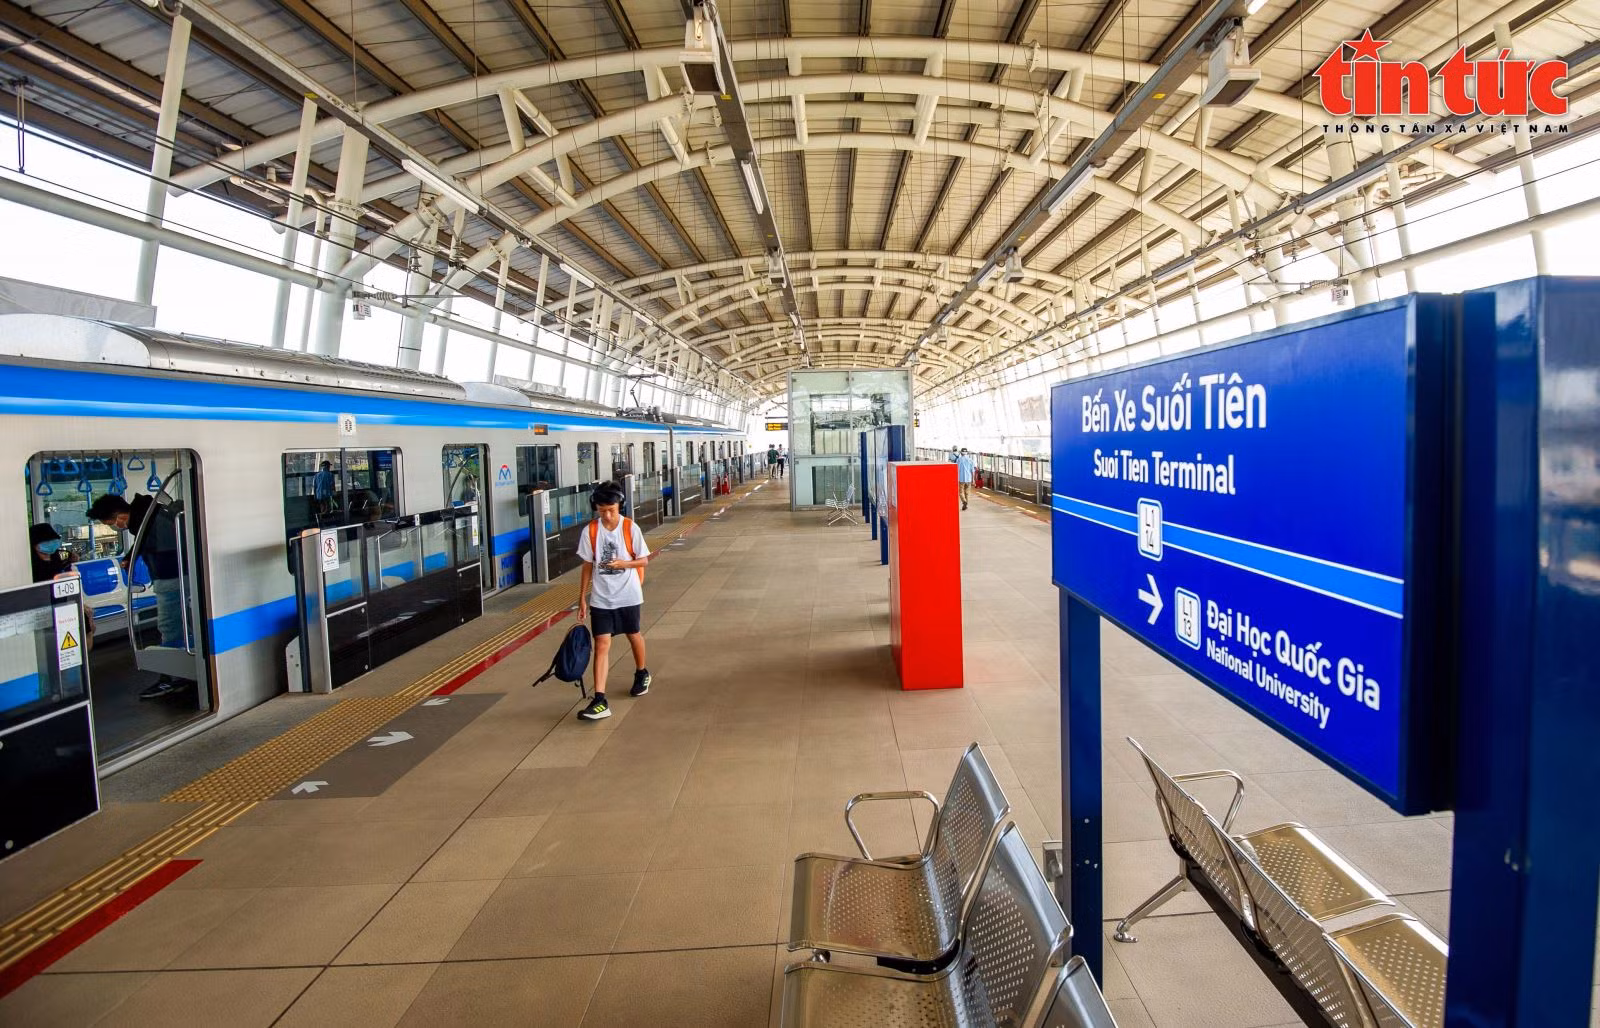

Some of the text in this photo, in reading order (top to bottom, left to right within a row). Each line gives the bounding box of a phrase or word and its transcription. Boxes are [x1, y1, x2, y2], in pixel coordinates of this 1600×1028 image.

[1081, 372, 1267, 433] Bến Xe Suối Tiên
[1094, 449, 1236, 496] Suoi Tien Terminal
[1145, 530, 1155, 551] 14
[56, 582, 75, 596] 1-09
[1182, 597, 1193, 618] L1
[1183, 618, 1193, 638] 13
[1206, 599, 1380, 711] Đại Học Quốc Gia
[1206, 637, 1331, 730] National University
